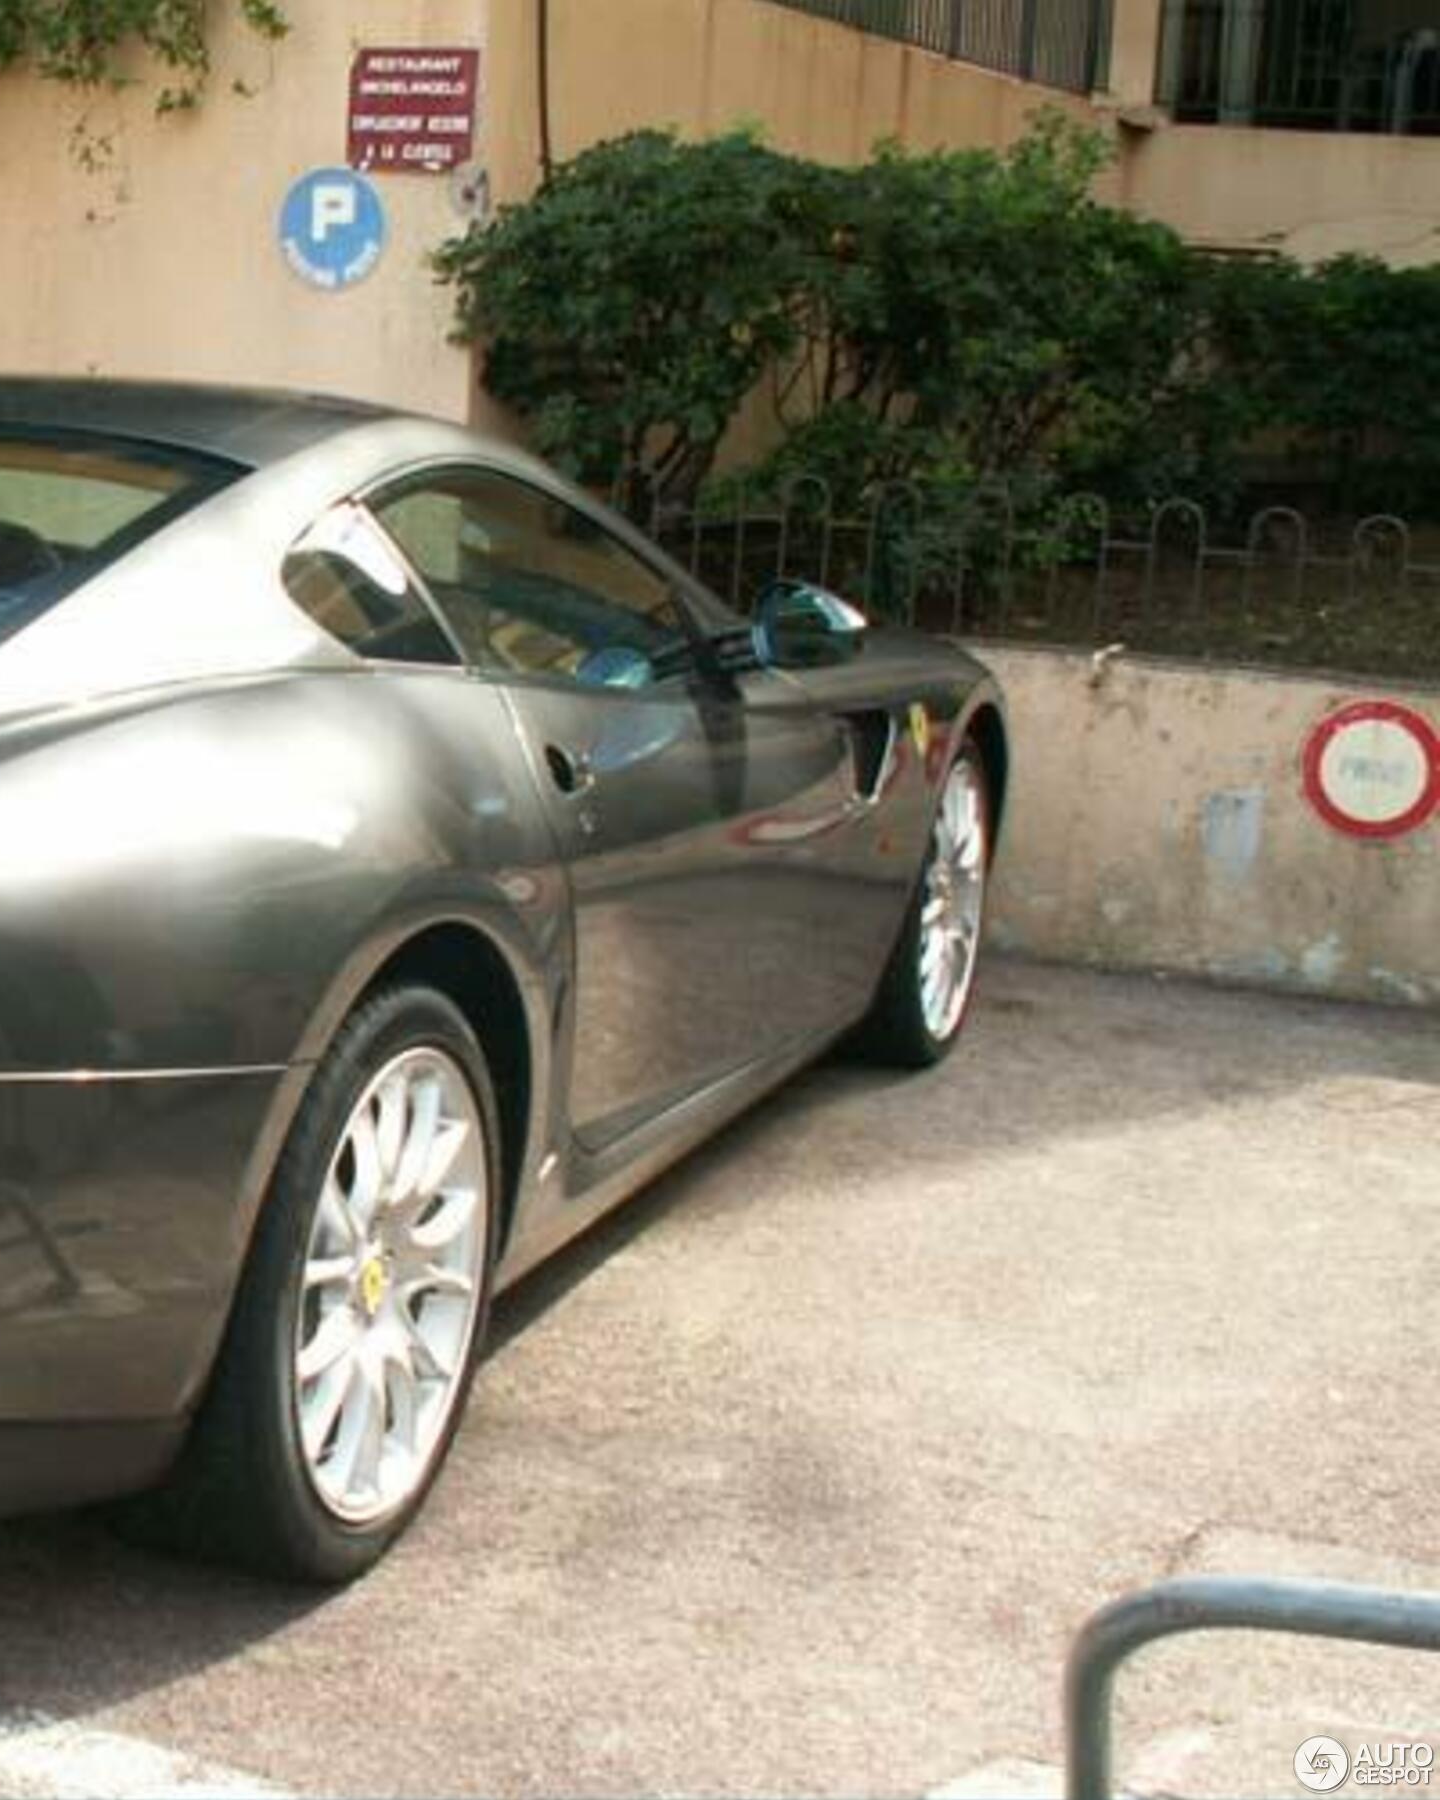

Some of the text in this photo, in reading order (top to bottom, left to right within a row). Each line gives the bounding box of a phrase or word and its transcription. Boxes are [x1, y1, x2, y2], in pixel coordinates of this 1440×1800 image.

[367, 56, 462, 73] RESTAURANT
[359, 80, 466, 96] MICHELANGELO
[311, 184, 357, 242] P
